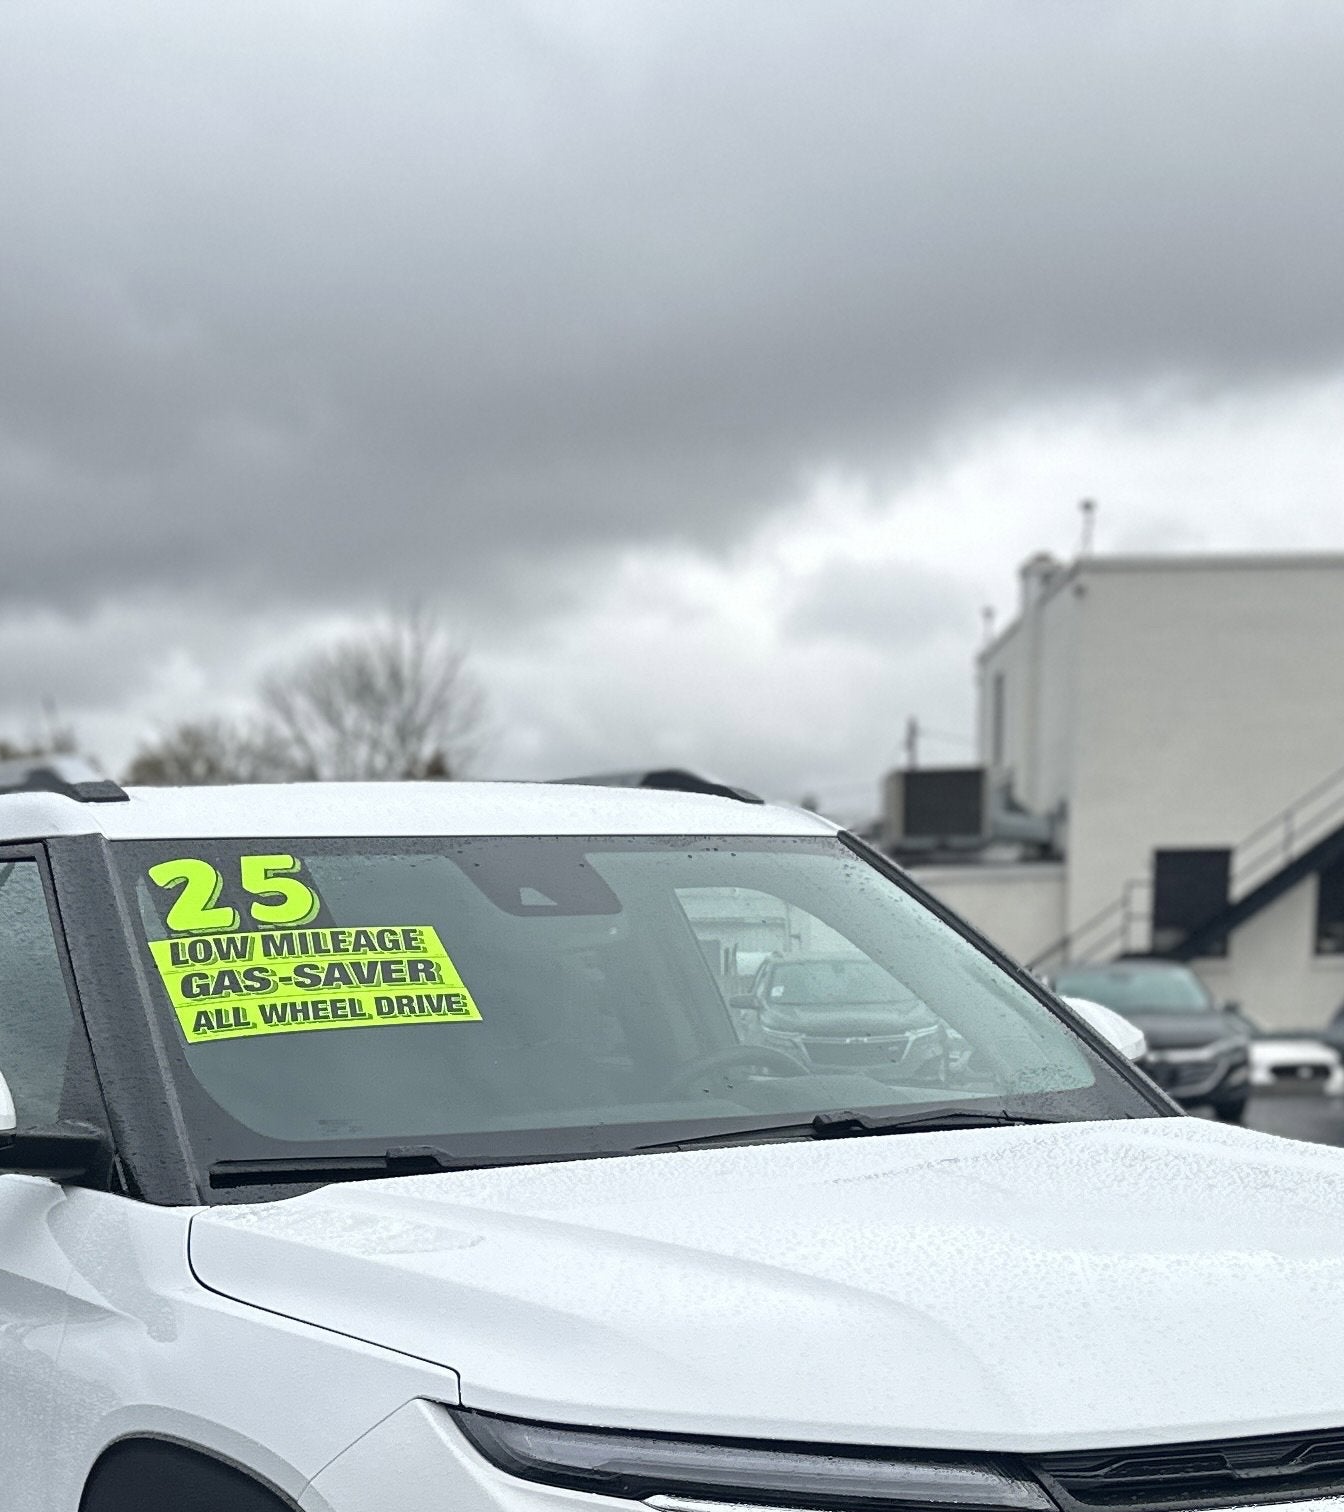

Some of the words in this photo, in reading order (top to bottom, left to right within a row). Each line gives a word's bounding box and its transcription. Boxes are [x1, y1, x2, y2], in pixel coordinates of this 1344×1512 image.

[148, 854, 318, 932] 25
[169, 934, 253, 967] LOW
[262, 929, 425, 958] MILEAGE
[181, 959, 441, 999] GAS-SAVER
[192, 1009, 255, 1034] ALL
[259, 998, 372, 1027] WHEEL
[374, 993, 469, 1018] DRIVE
